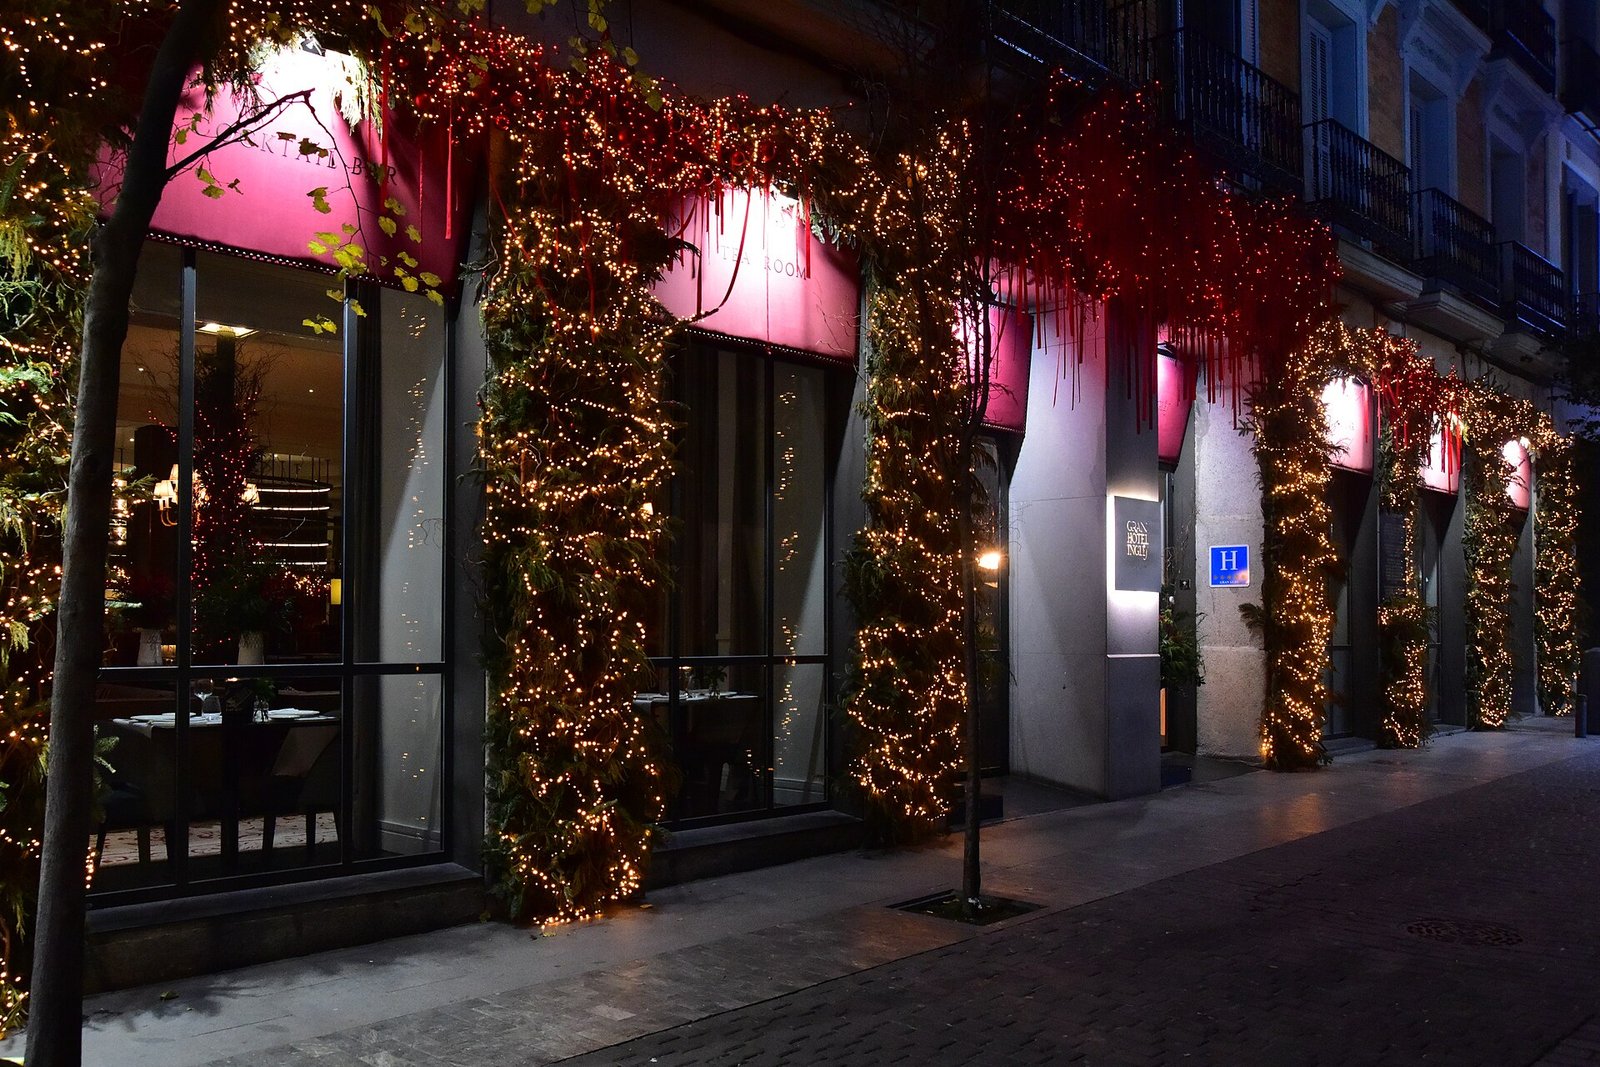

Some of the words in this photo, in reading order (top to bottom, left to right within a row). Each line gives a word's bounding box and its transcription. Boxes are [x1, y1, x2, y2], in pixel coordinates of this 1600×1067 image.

[351, 157, 397, 186] BR
[720, 245, 751, 265] TEA
[764, 256, 807, 280] ROOM
[1126, 520, 1148, 533] GRAN
[1126, 533, 1149, 545] HOTEL
[1219, 550, 1238, 571] H
